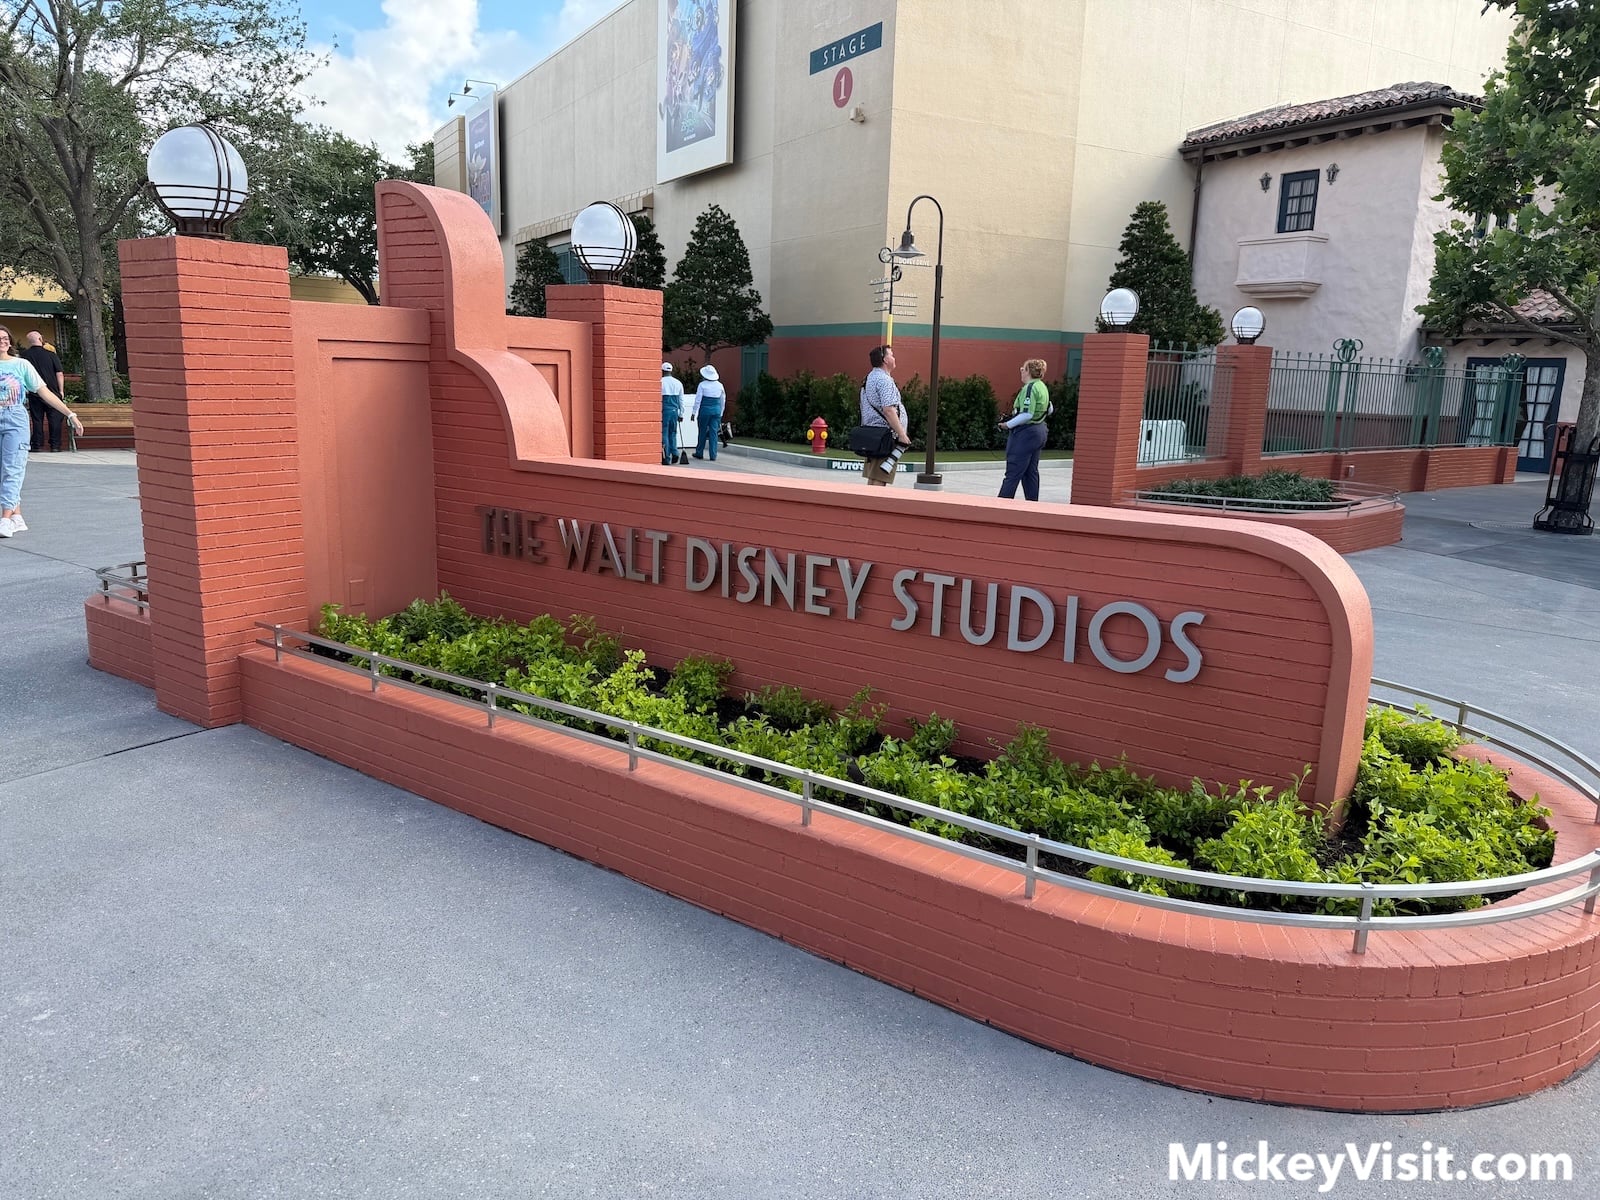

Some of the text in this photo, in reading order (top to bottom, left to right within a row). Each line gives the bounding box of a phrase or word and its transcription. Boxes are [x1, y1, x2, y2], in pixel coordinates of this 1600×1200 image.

[823, 33, 867, 66] STAGE
[838, 73, 847, 101] 1
[475, 506, 1207, 684] THE WALT DISNEY STUDIOS
